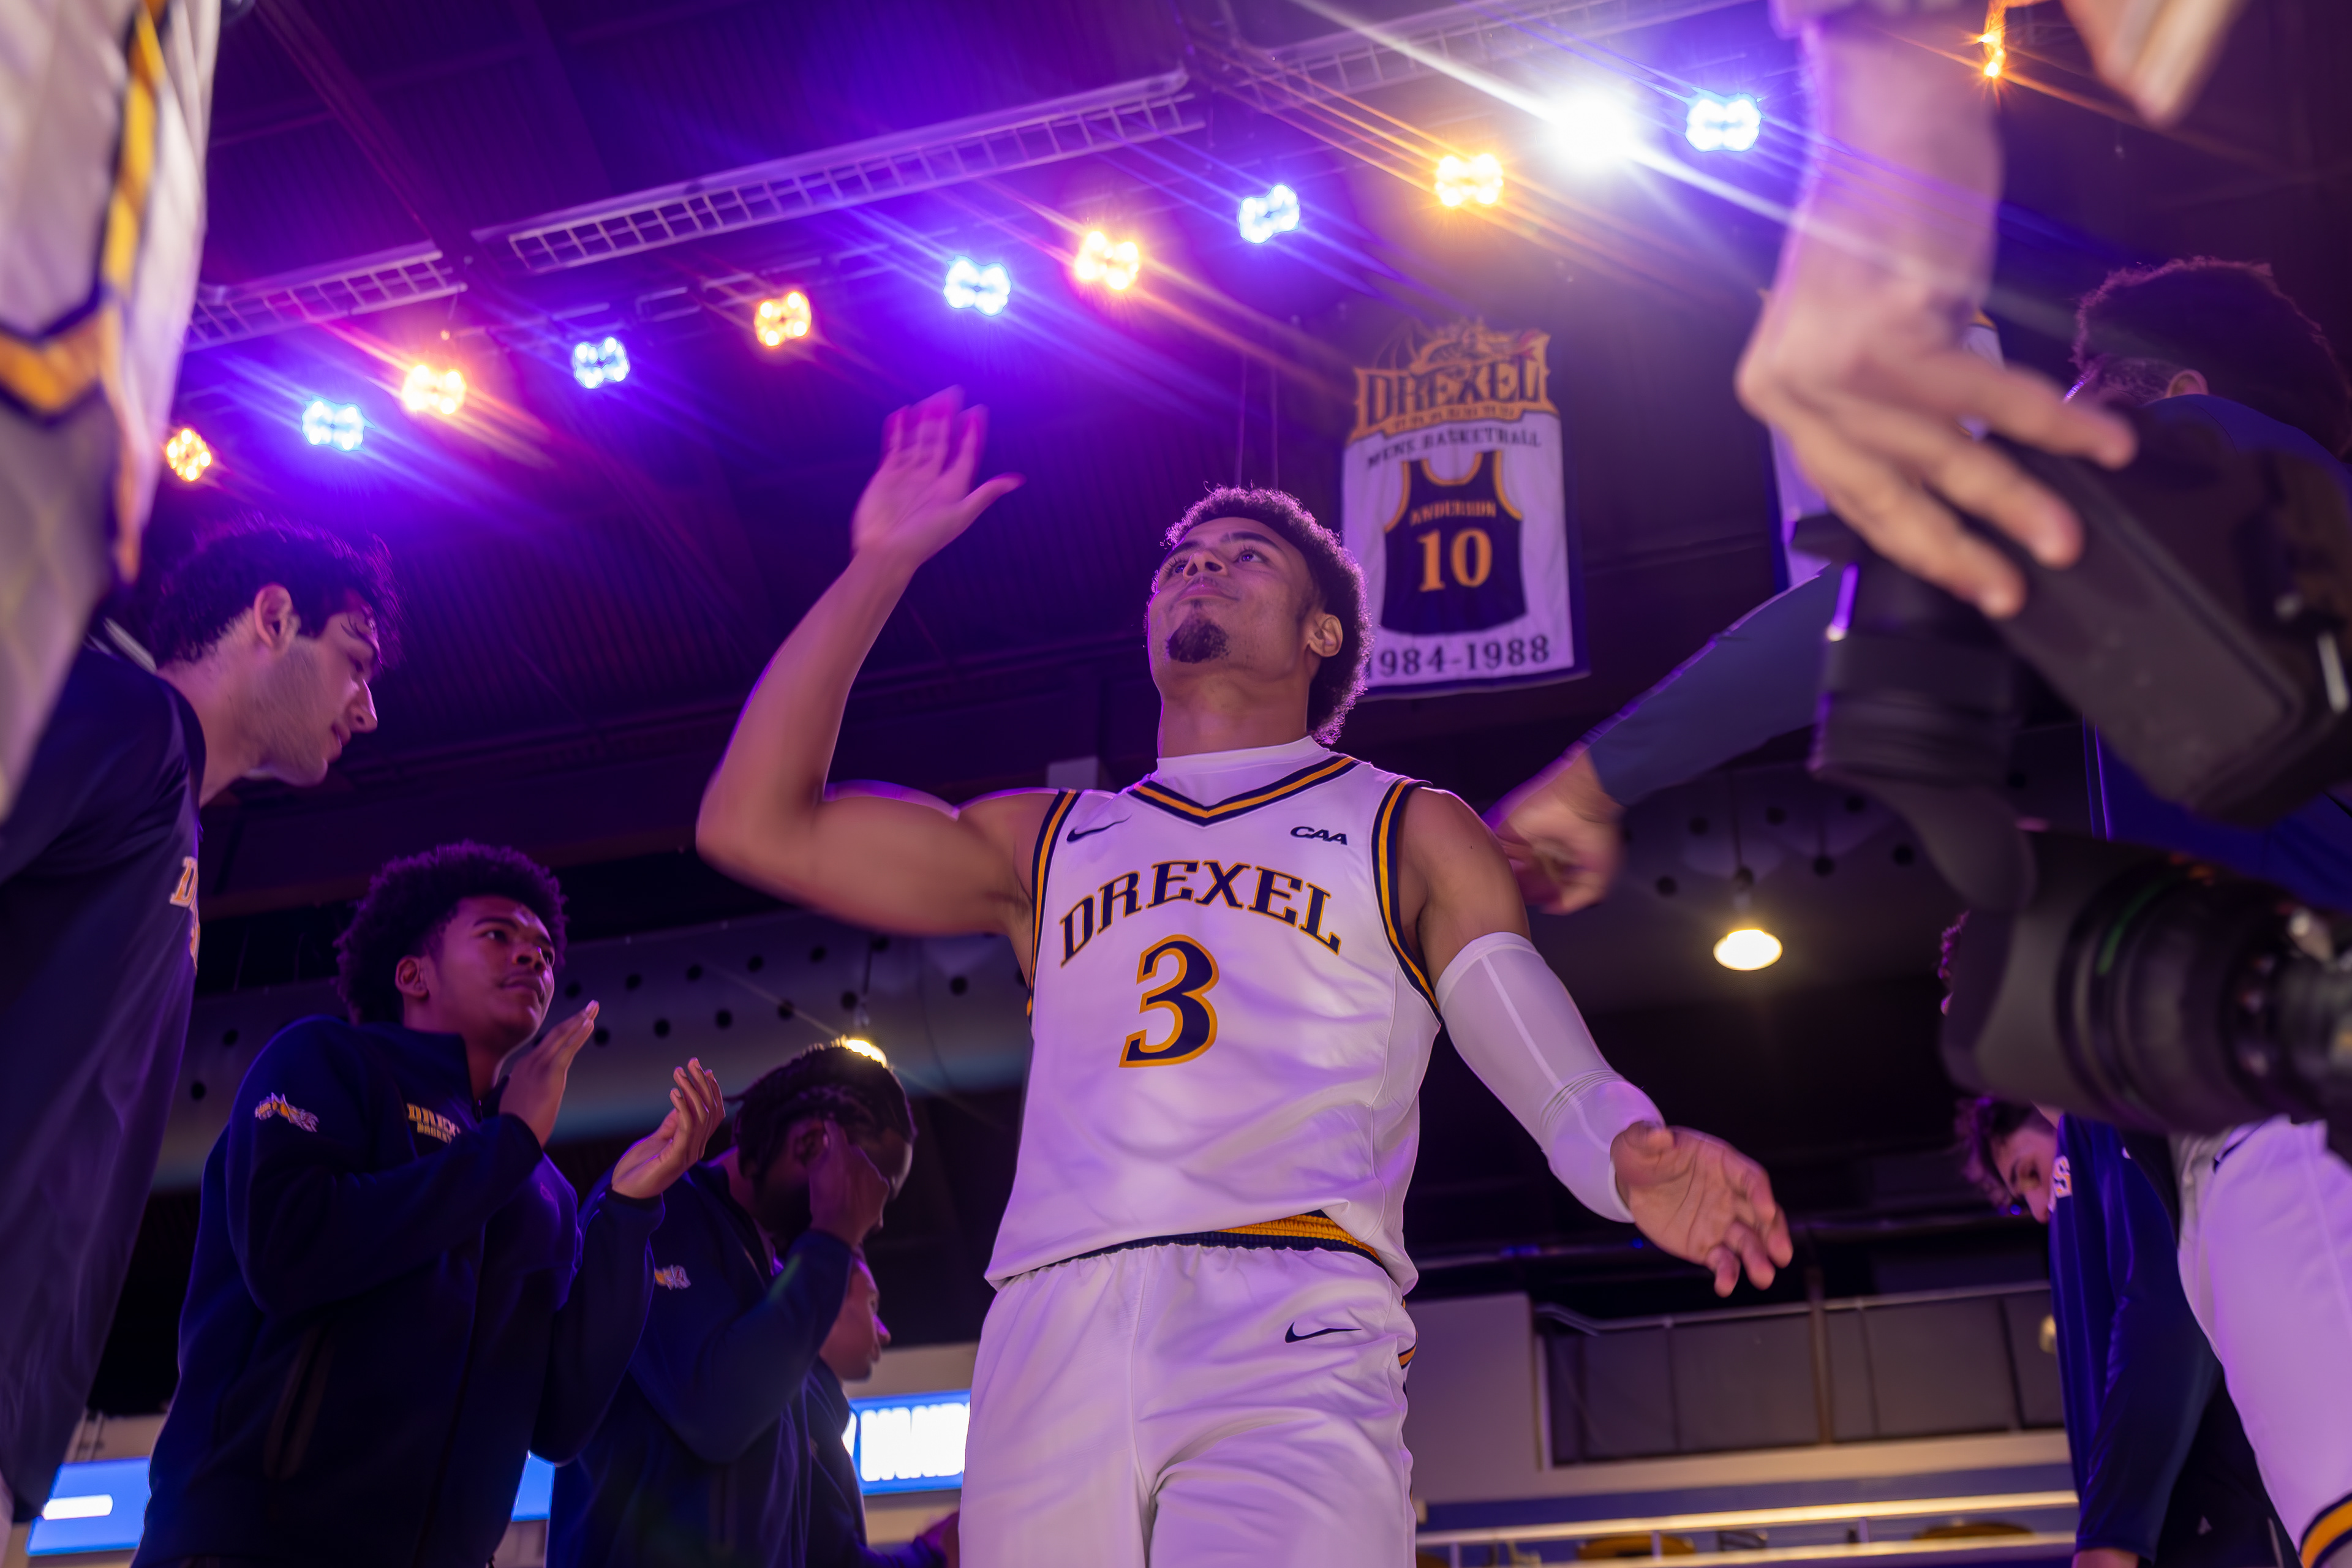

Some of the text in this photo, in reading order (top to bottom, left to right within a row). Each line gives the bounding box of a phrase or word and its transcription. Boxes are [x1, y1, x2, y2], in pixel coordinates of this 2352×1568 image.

[1355, 354, 1548, 430] DREXEL
[1423, 427, 1541, 449] BASKETBALL
[1409, 498, 1496, 527] ANDERSON
[1417, 527, 1493, 593] 10
[1289, 826, 1348, 846] CAA
[1059, 859, 1342, 968] DREXEL
[1118, 933, 1220, 1068] 3
